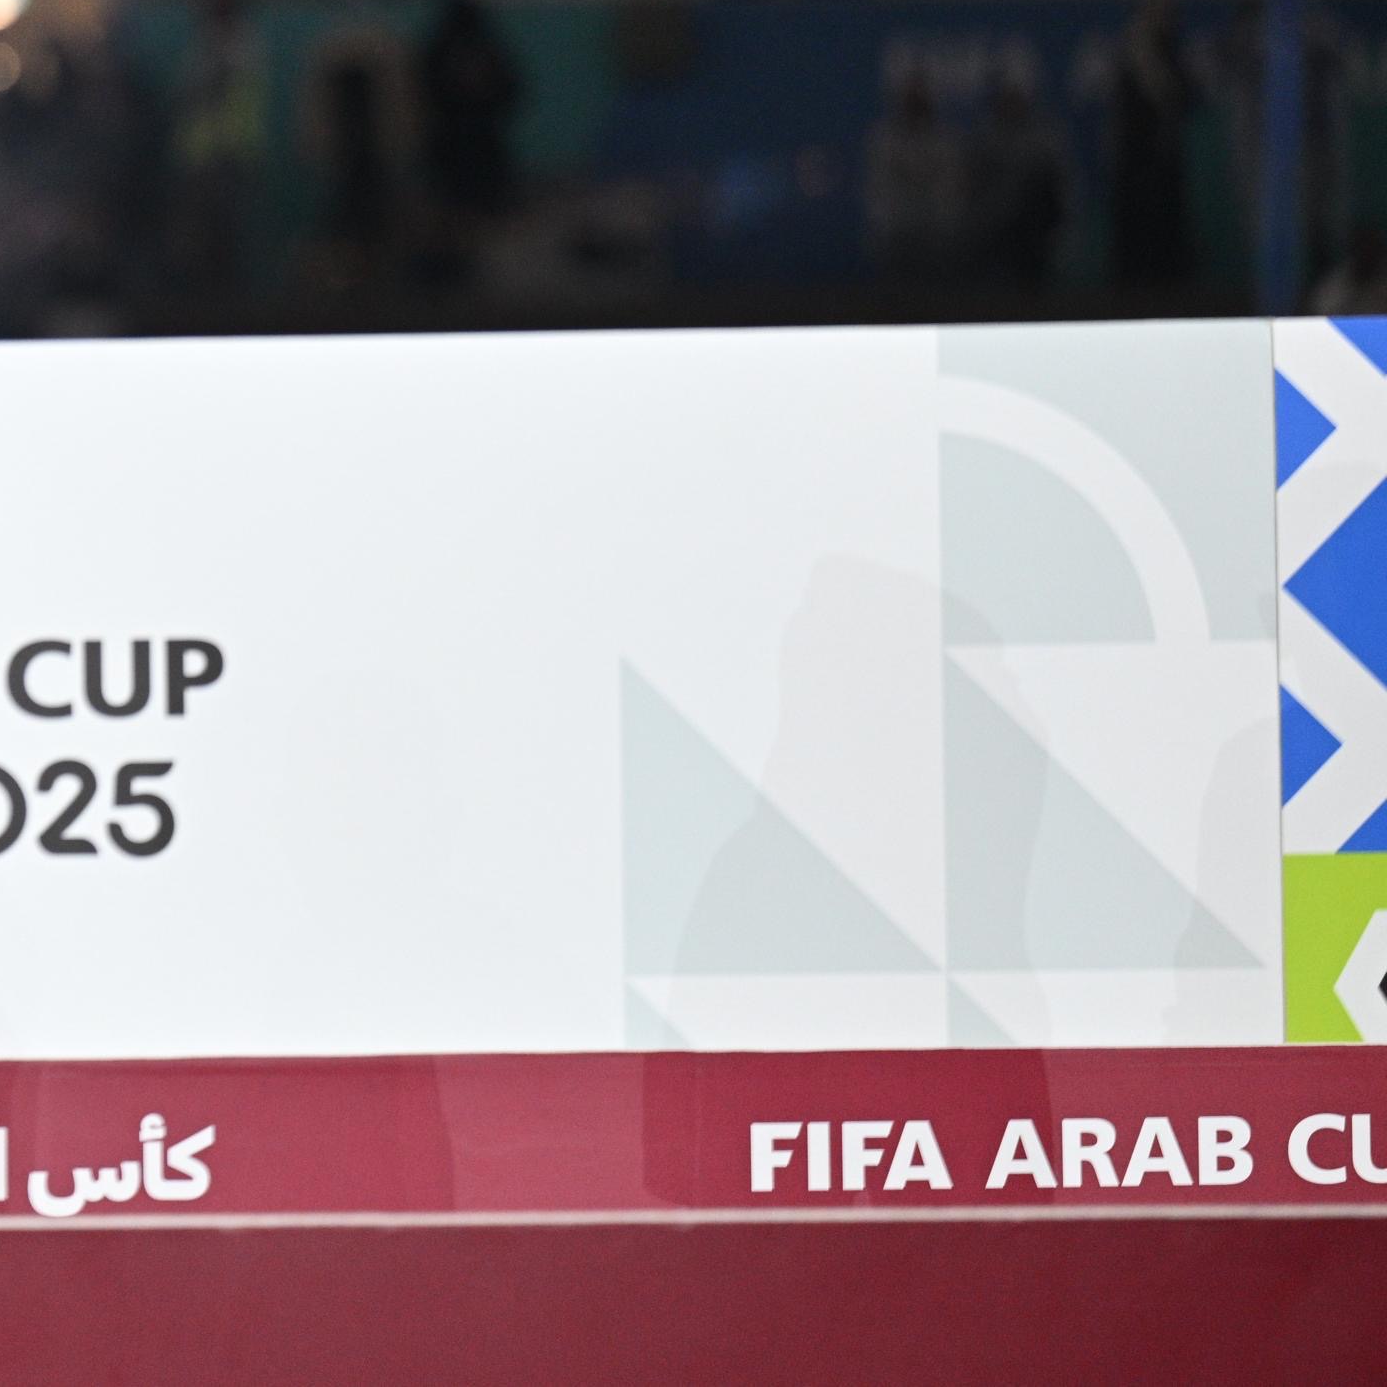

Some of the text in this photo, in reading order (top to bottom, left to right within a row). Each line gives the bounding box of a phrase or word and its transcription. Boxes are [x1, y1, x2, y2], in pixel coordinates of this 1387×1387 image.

[7, 639, 224, 717] CUP
[27, 1113, 216, 1217] كأس
[750, 1112, 1387, 1192] FIFA ARAB CU
